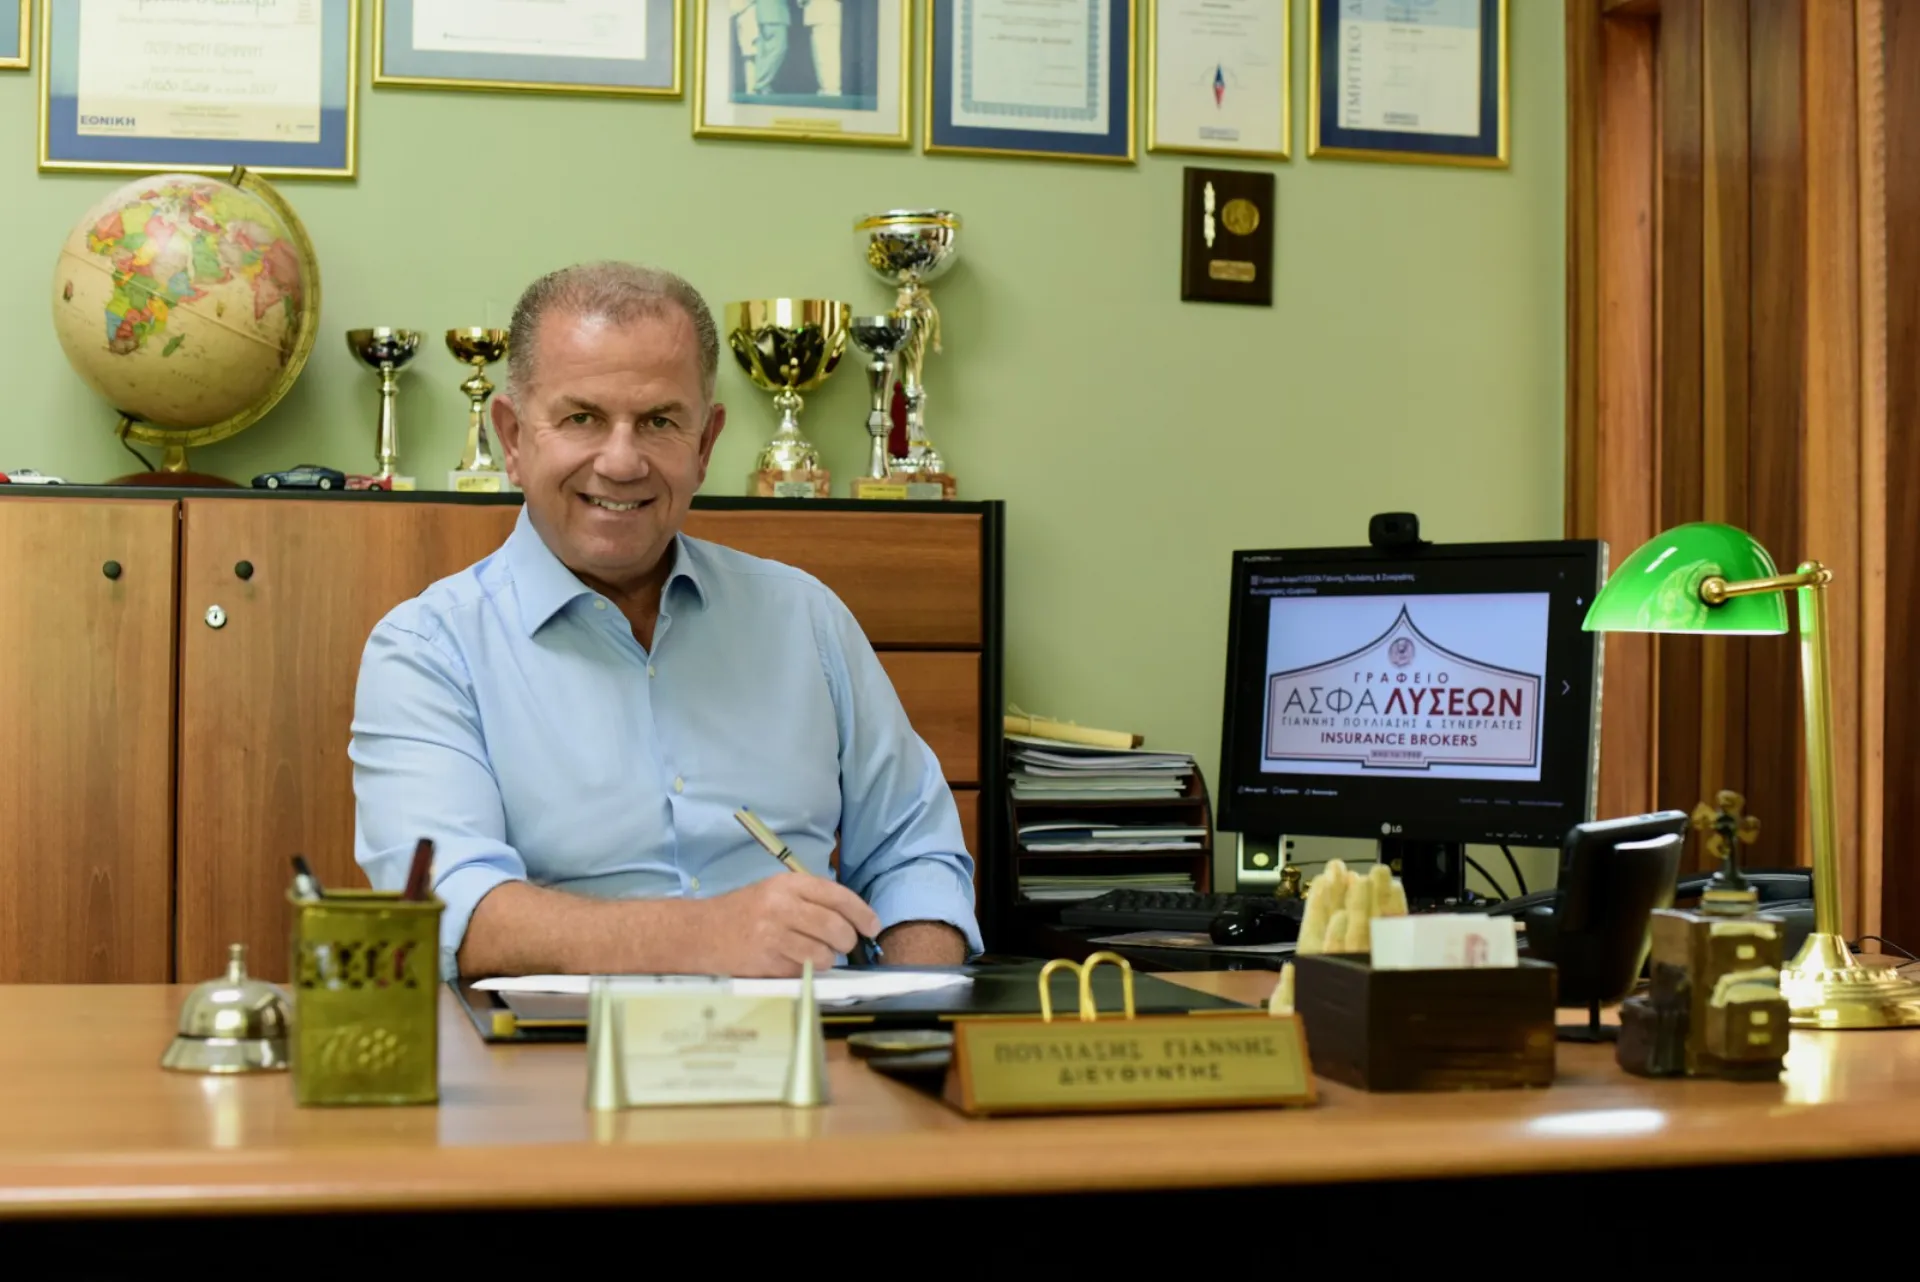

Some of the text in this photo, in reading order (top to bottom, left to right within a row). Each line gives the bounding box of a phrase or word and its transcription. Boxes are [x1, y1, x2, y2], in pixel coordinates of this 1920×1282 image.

[1354, 672, 1449, 684] ΓΡΑΦΕΙΟ
[1283, 686, 1523, 717] ΑΣΦΑΛΥΣΕΩΝ
[1281, 716, 1523, 731] ΓΙΑΝΝΗΣ ΠΟΥΛΙΑΣΗΣ & ΣΥΝΕΡΓΑΤΕΣ
[1320, 731, 1478, 748] INSURANCE BROKERS
[994, 1036, 1278, 1063] ΠΟΥΛΙΑΣΗΣ ΓΙΑΝΝΗΣ
[1059, 1062, 1222, 1086] ΔΙΕΥΘΥΝΤΗΣ
